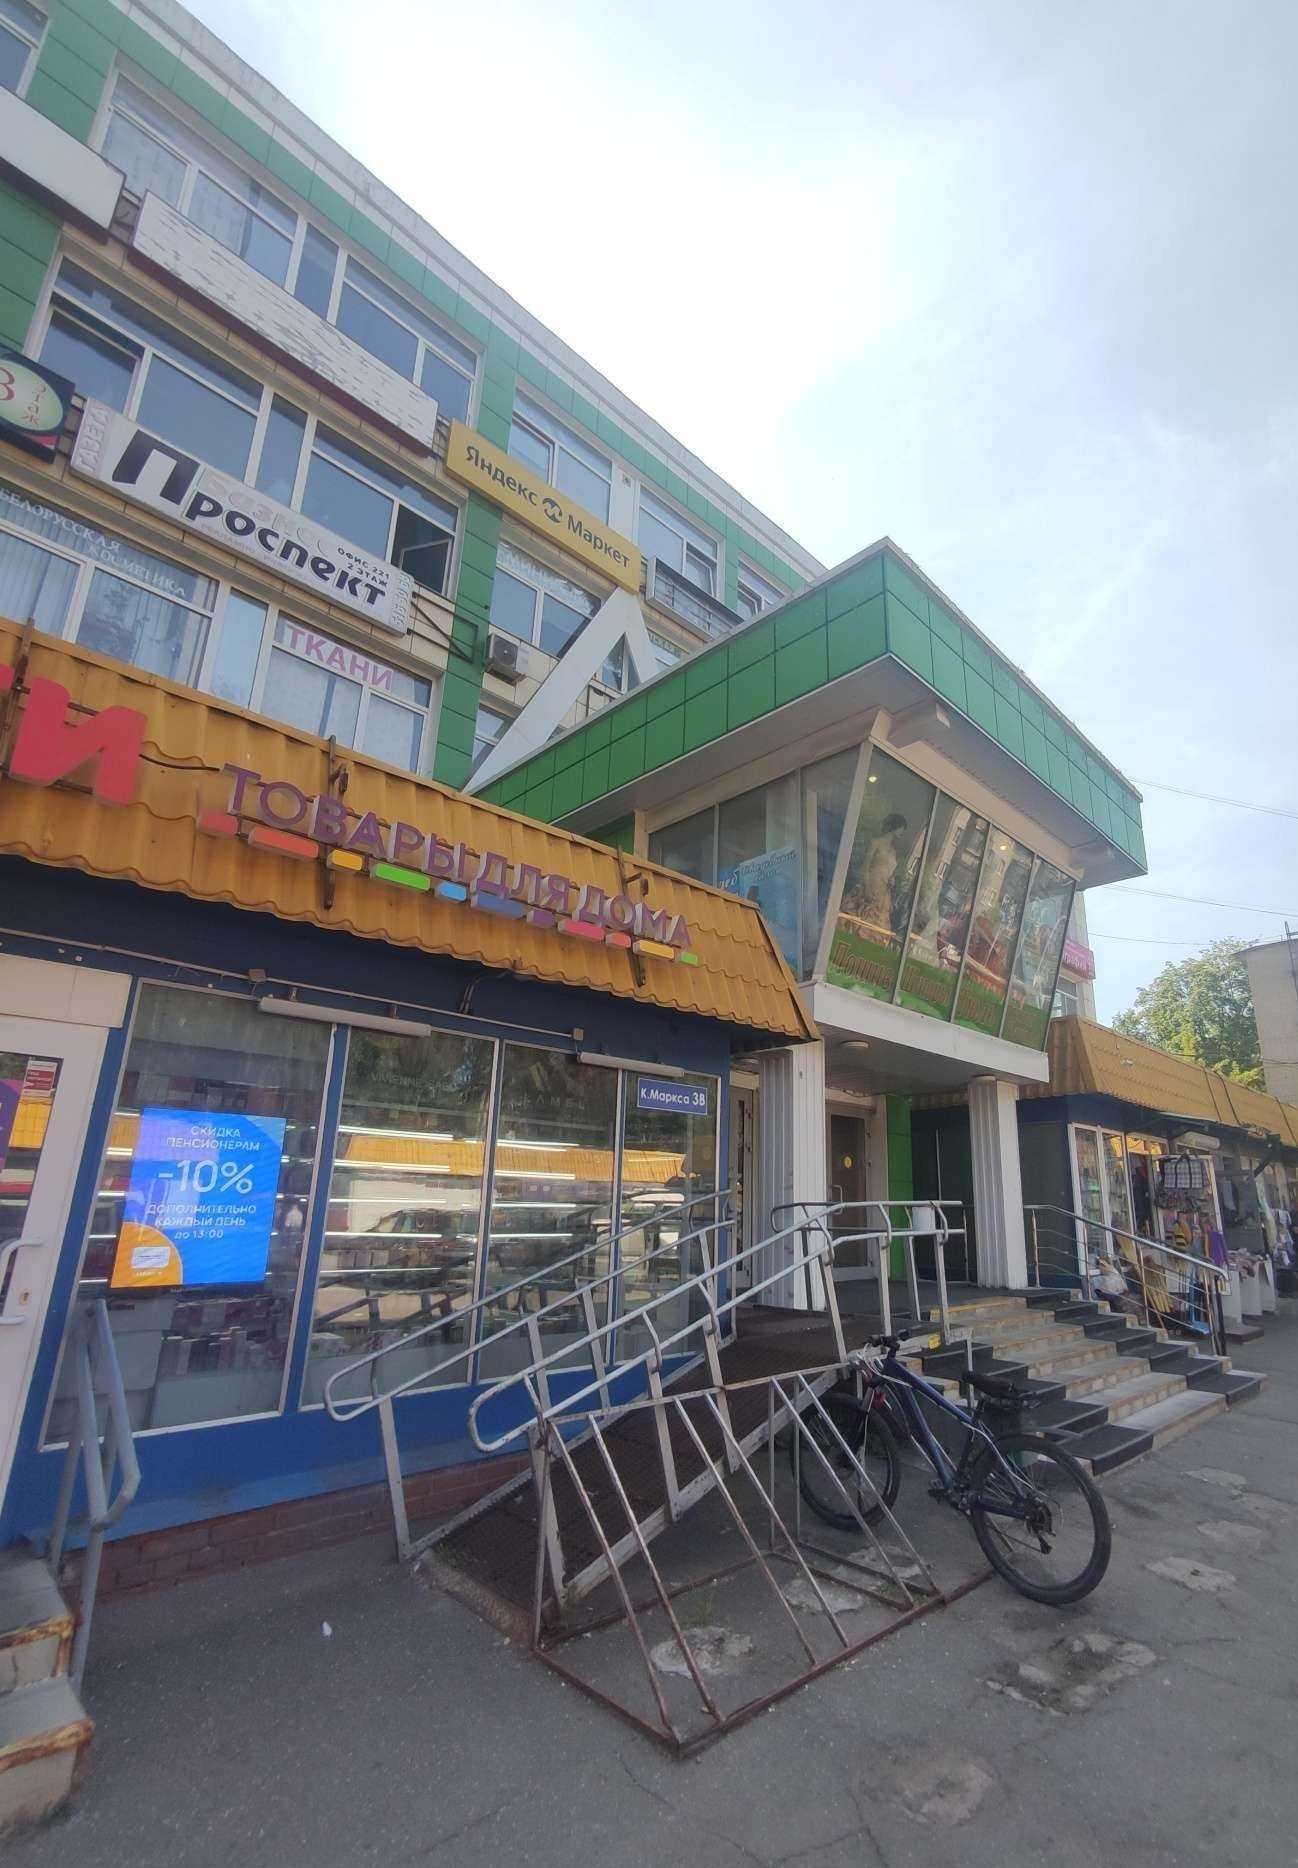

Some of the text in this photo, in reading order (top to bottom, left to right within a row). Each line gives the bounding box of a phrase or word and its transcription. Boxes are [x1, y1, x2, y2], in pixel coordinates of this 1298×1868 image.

[112, 429, 386, 606] Проспект
[466, 446, 631, 568] Яндекс Маркет
[337, 546, 390, 580] ОФИС 221
[347, 562, 388, 587] 2 ЭТАЖ
[289, 627, 394, 691] ТКАНИ
[221, 763, 693, 951] ТОВАРЫ ДЛЯ ДОМА
[640, 1087, 690, 1105] К.Маркса
[166, 1137, 260, 1151] ПЕНСИОНЕРАМ
[190, 1125, 241, 1138] СКИДКА
[158, 1160, 255, 1194] -10%
[146, 1203, 257, 1216] ДОПОЛНИТЕЛЬНО
[154, 1215, 246, 1228] КАЖДЫЙ ДЕНЬ
